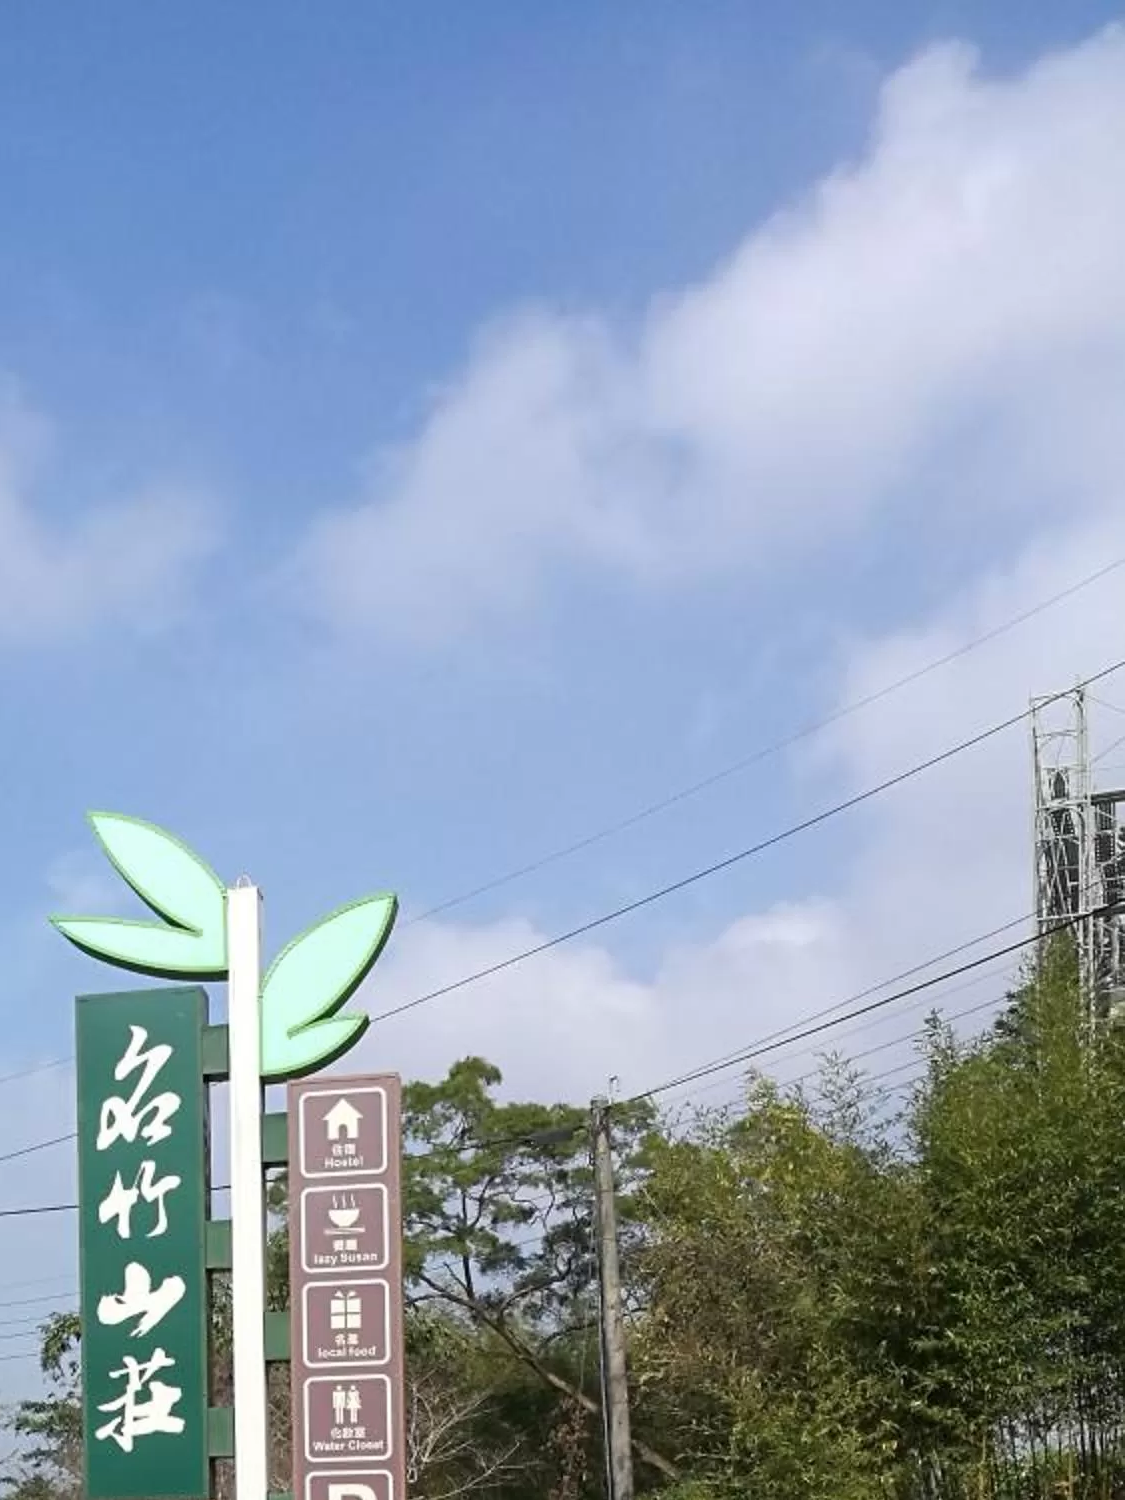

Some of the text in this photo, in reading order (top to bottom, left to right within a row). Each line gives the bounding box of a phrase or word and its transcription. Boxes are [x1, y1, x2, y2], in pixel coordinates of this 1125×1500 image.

[324, 1155, 364, 1168] Hostel
[340, 1251, 378, 1263] Susan
[348, 1345, 377, 1357] food
[312, 1440, 345, 1451] Water
